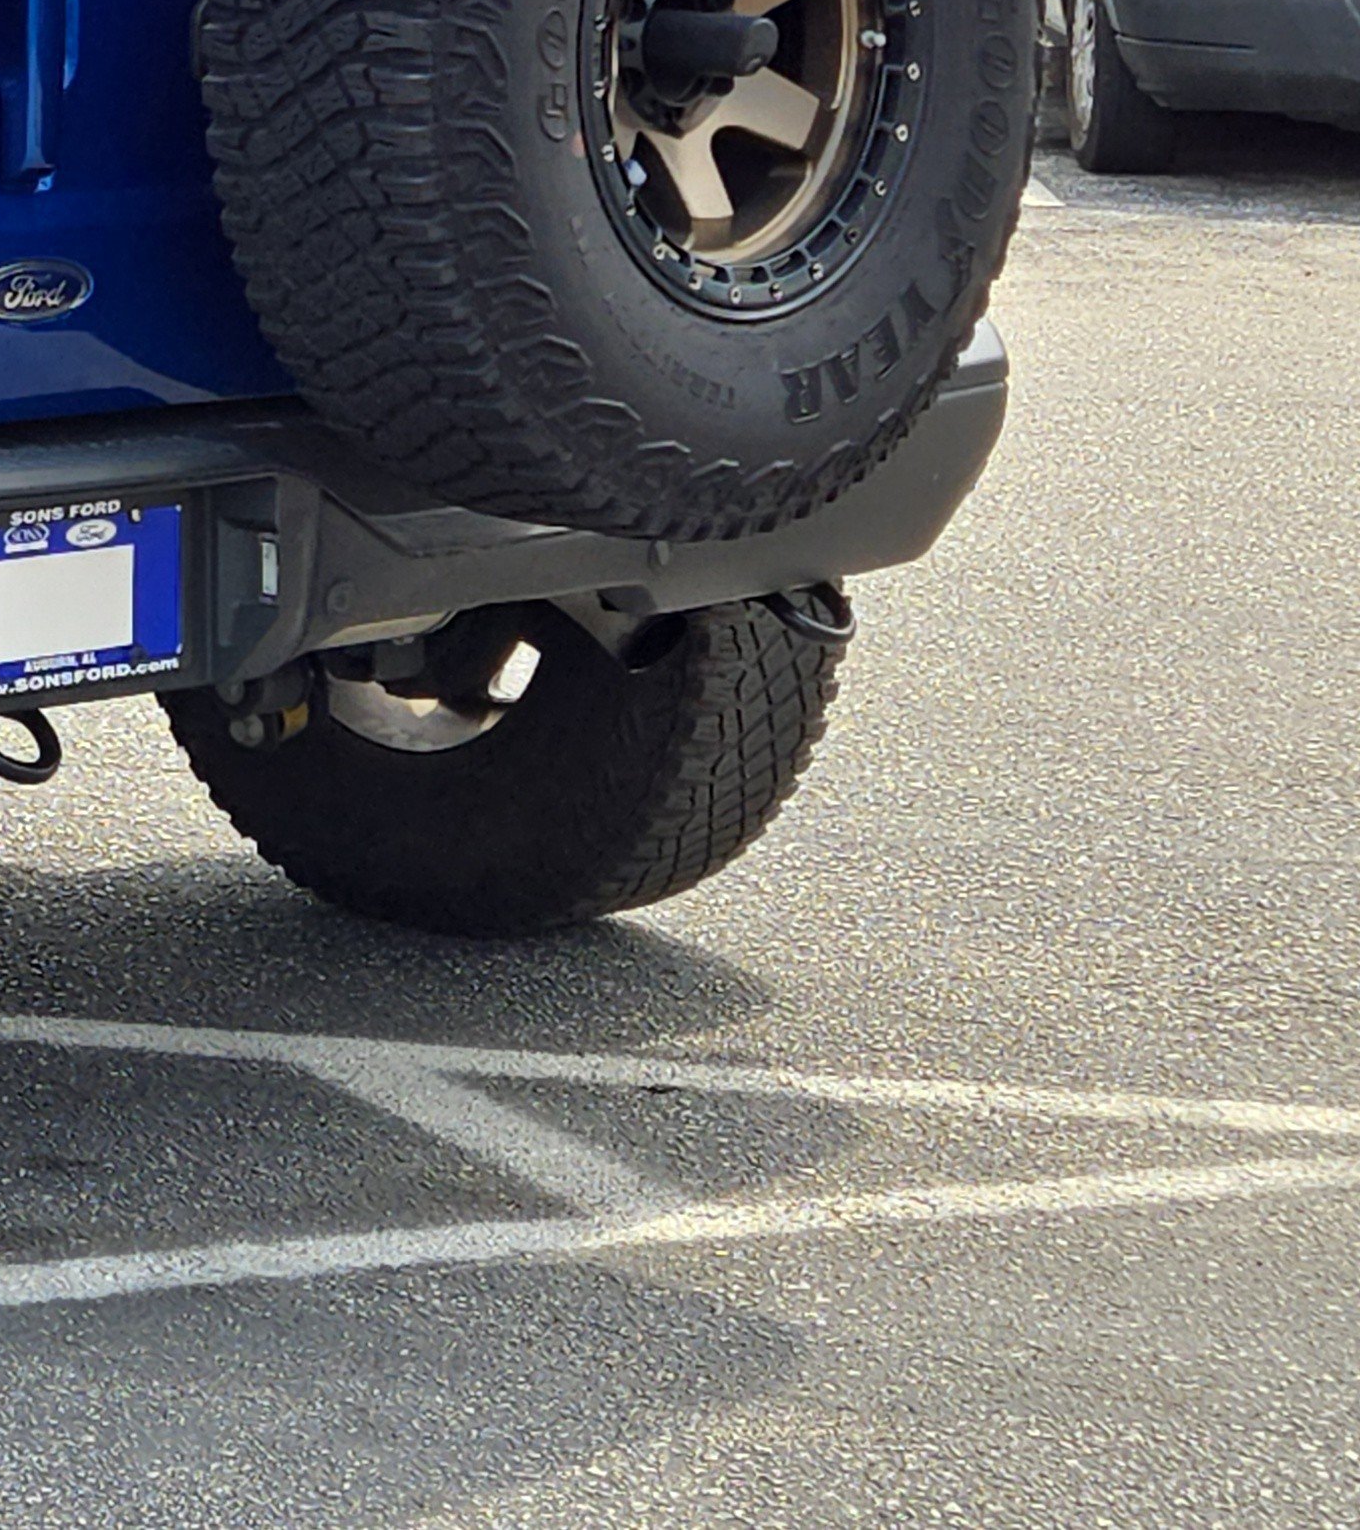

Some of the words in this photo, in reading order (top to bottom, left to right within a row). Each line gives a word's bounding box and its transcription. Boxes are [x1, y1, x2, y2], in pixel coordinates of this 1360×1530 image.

[4, 274, 66, 309] Ford
[9, 506, 65, 527] SONS
[68, 499, 121, 519] FORD
